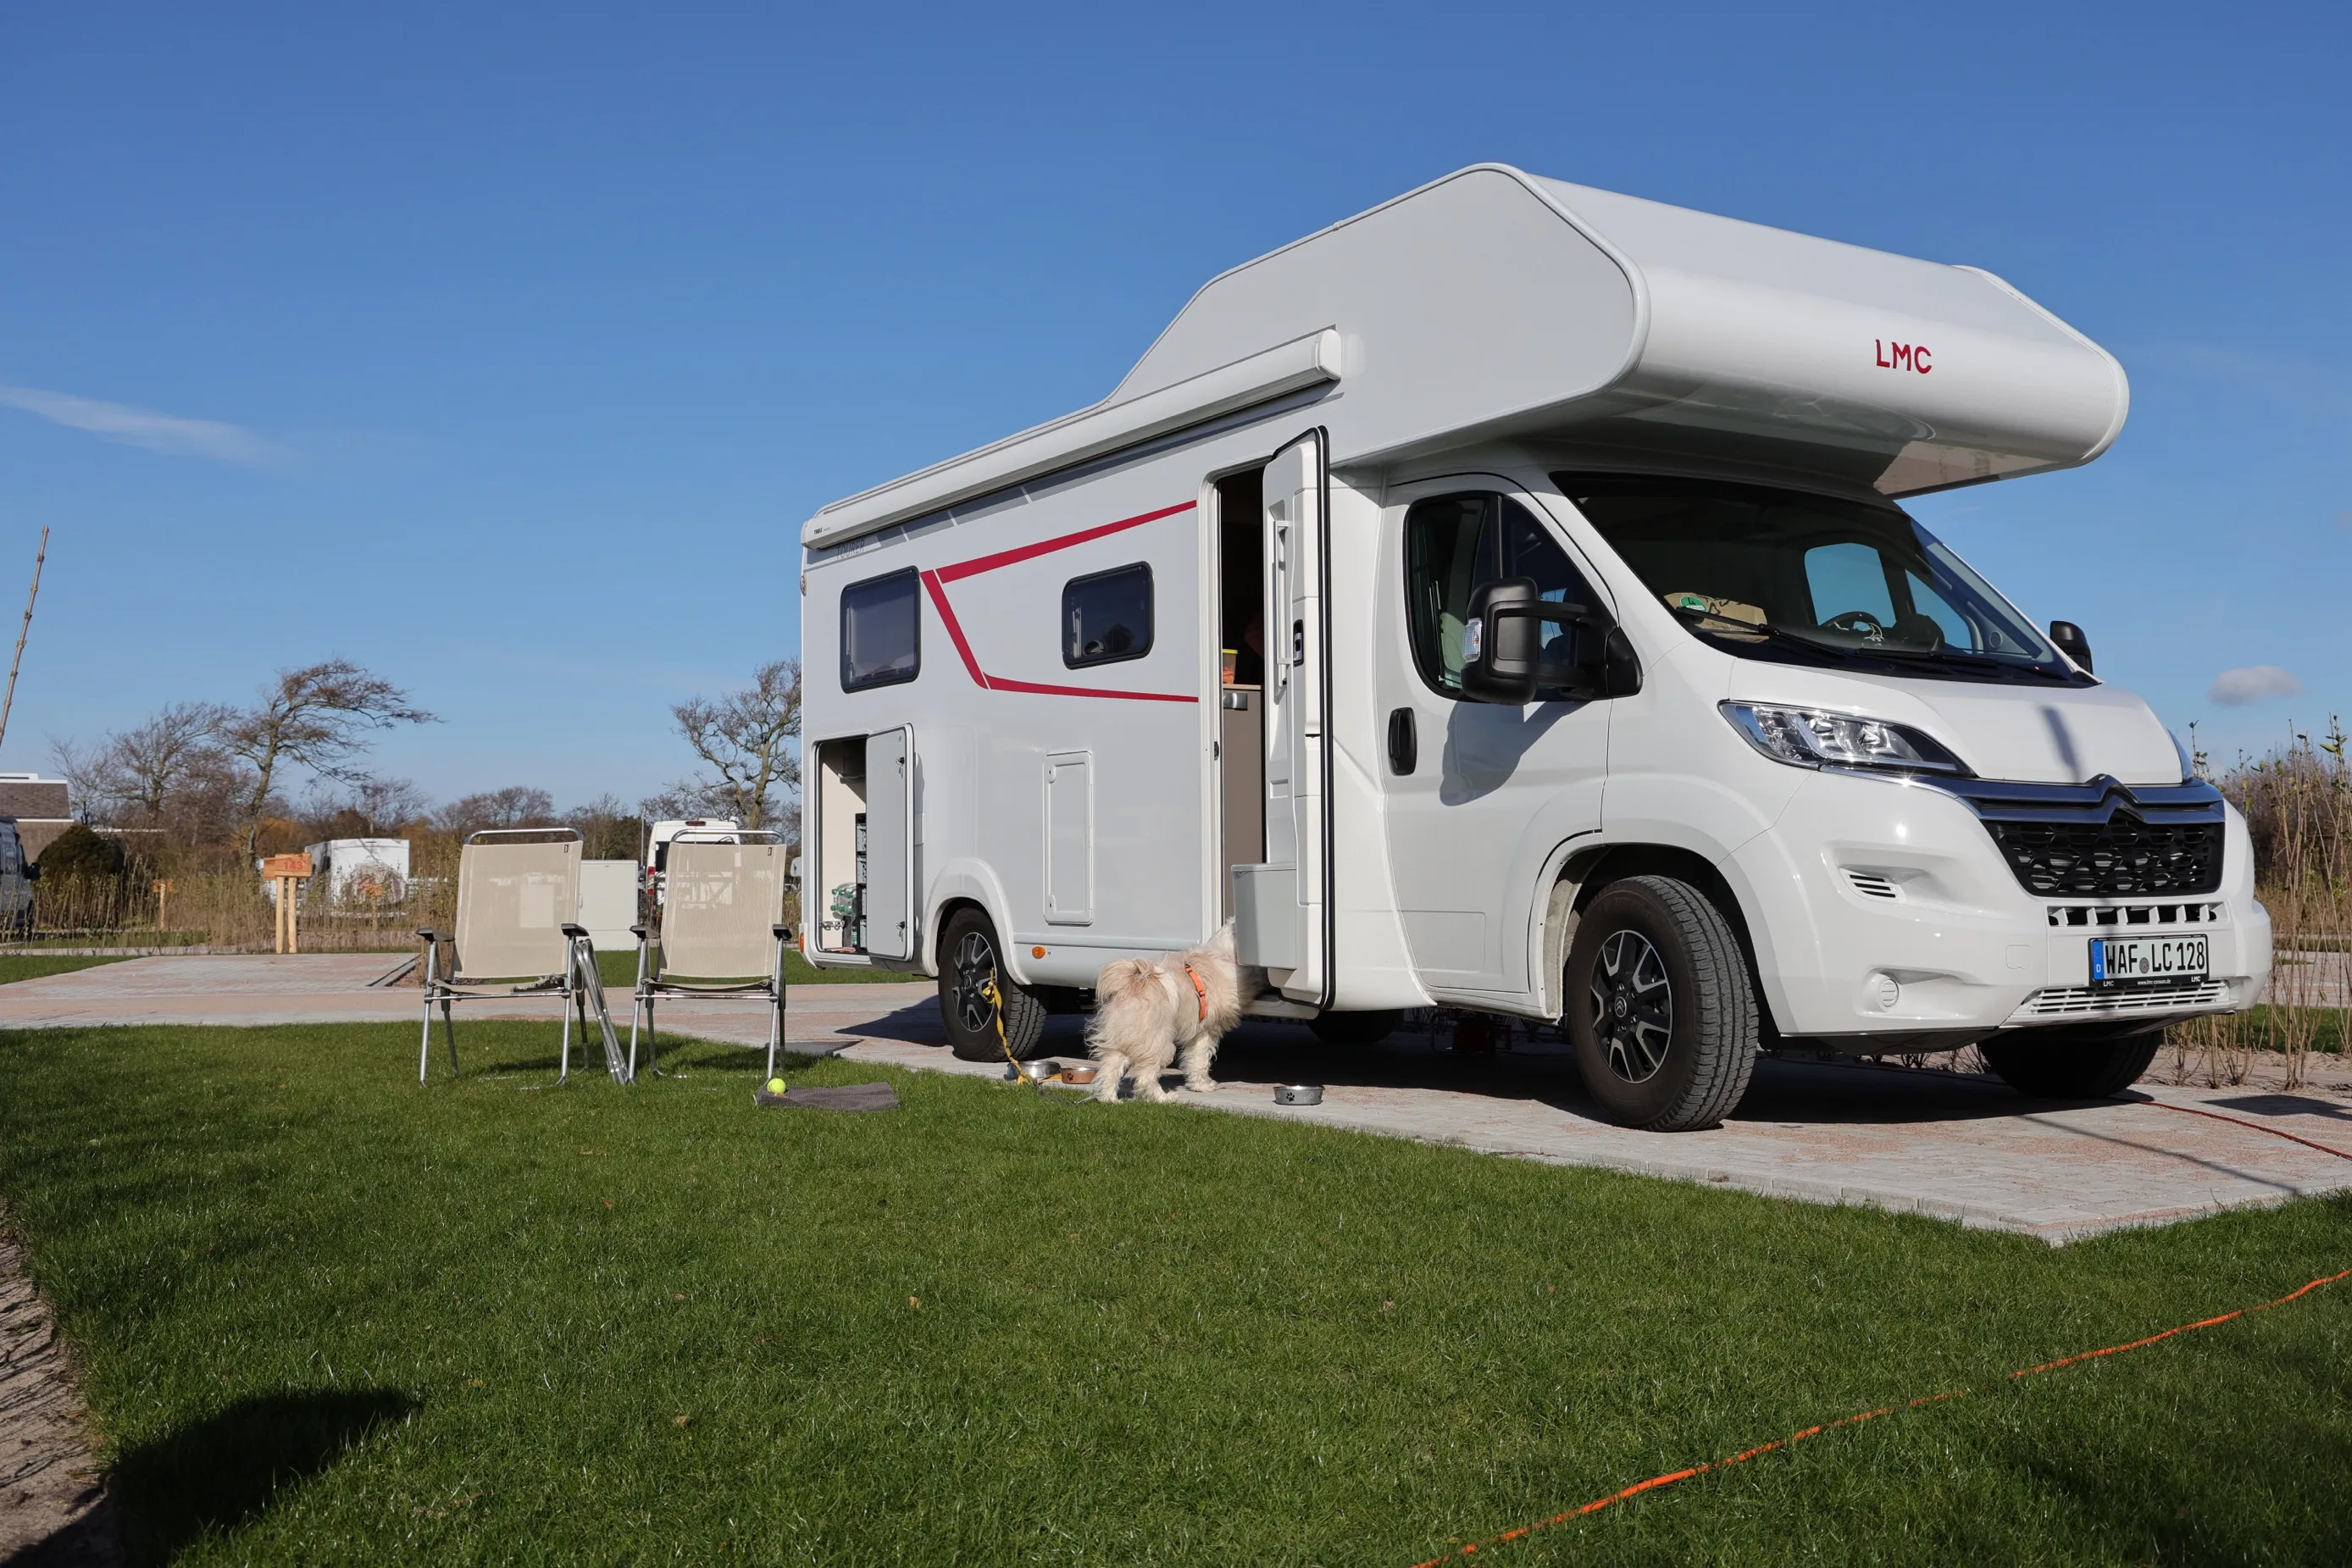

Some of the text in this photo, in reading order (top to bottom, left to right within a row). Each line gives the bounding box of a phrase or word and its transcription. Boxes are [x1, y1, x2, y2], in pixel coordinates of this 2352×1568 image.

[1875, 339, 1933, 374] LMC
[835, 539, 865, 560] TOURER
[1688, 596, 1696, 606] 4
[283, 860, 303, 871] 143
[2105, 941, 2205, 974] WAF LC 128
[2095, 964, 2101, 973] D
